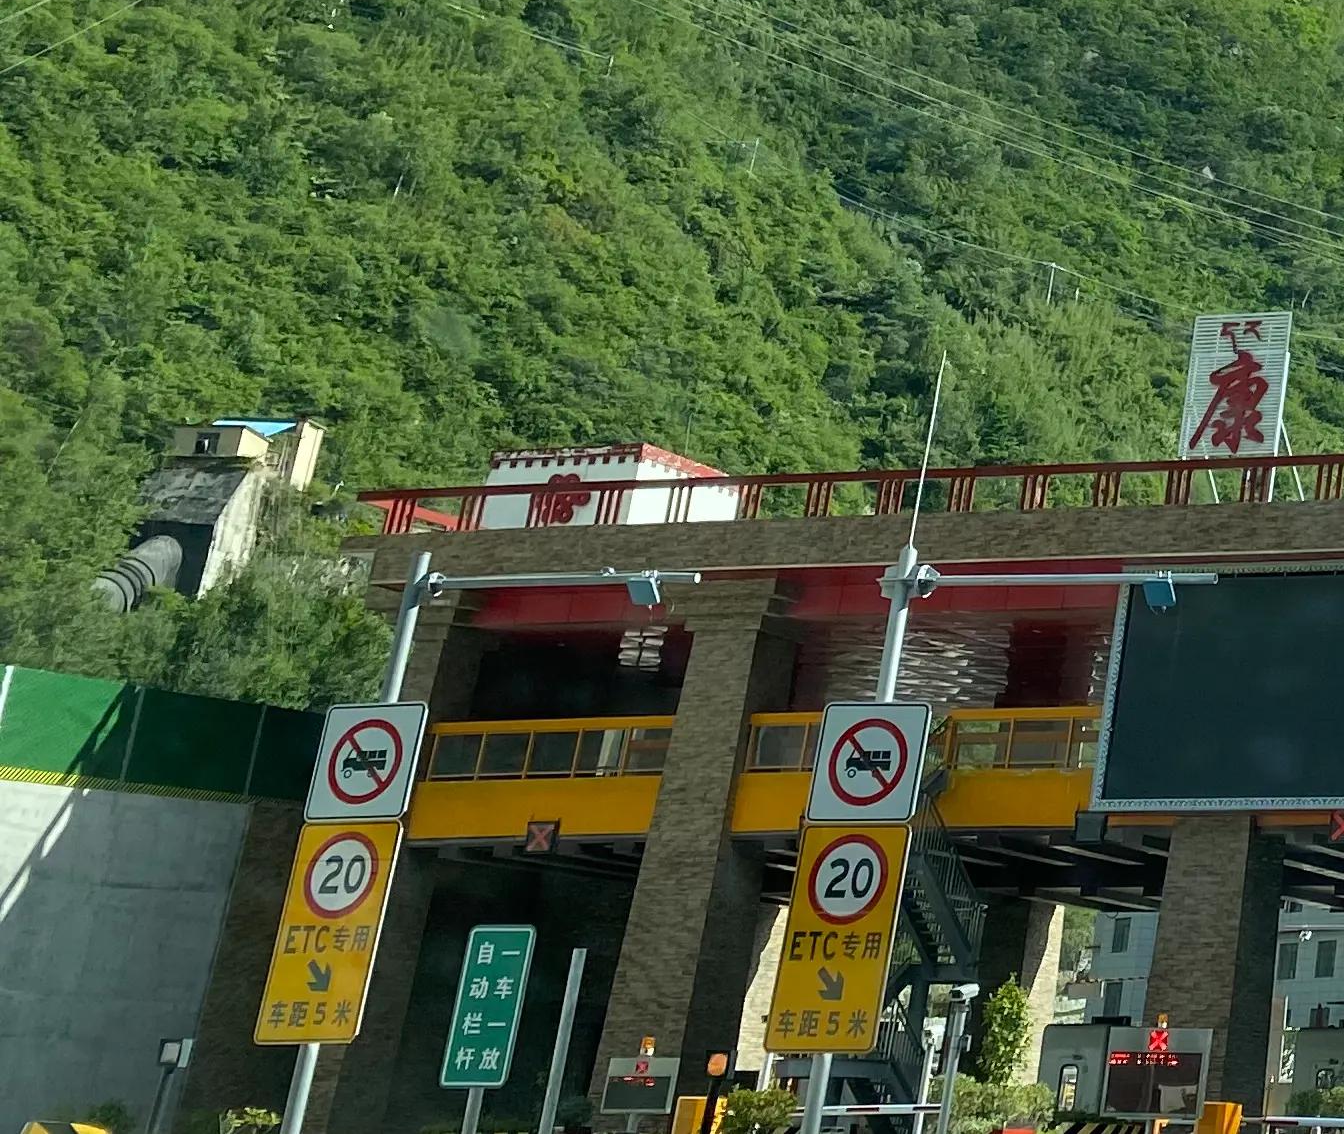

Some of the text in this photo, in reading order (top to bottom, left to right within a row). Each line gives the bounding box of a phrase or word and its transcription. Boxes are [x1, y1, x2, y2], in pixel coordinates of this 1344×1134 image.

[1189, 351, 1269, 454] 康
[318, 855, 366, 894] 20
[824, 858, 874, 899] 20
